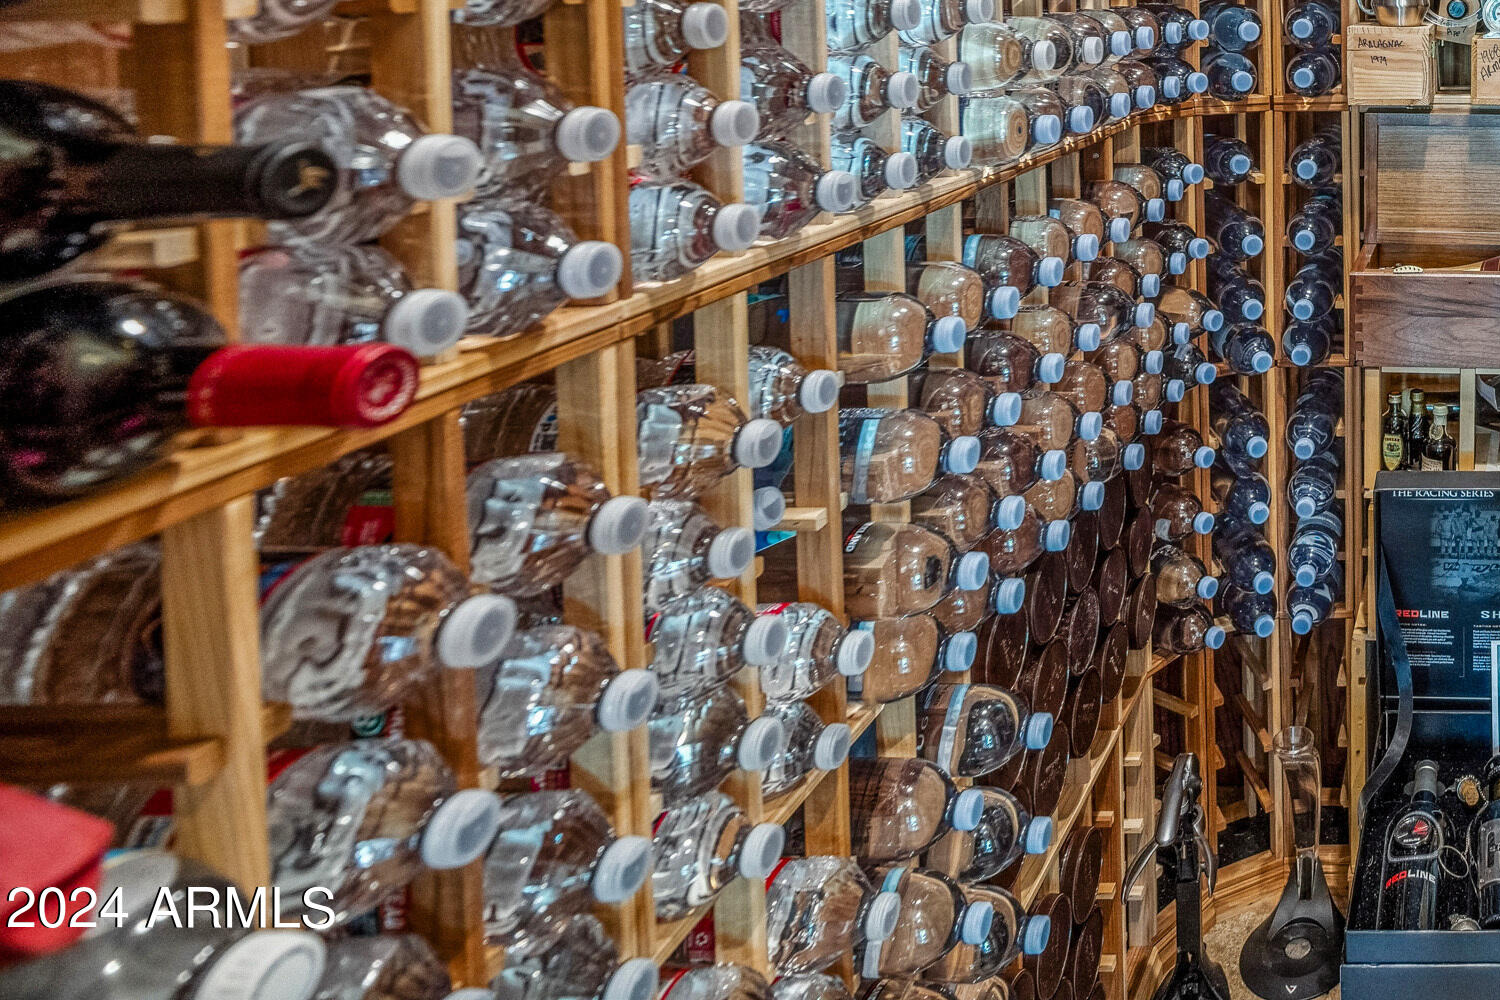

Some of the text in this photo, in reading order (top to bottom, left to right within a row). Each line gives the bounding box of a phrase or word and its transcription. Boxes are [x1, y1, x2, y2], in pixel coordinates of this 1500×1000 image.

[1414, 490, 1459, 498] RACING
[1459, 490, 1495, 498] SERIES
[1385, 868, 1438, 890] REDLINE
